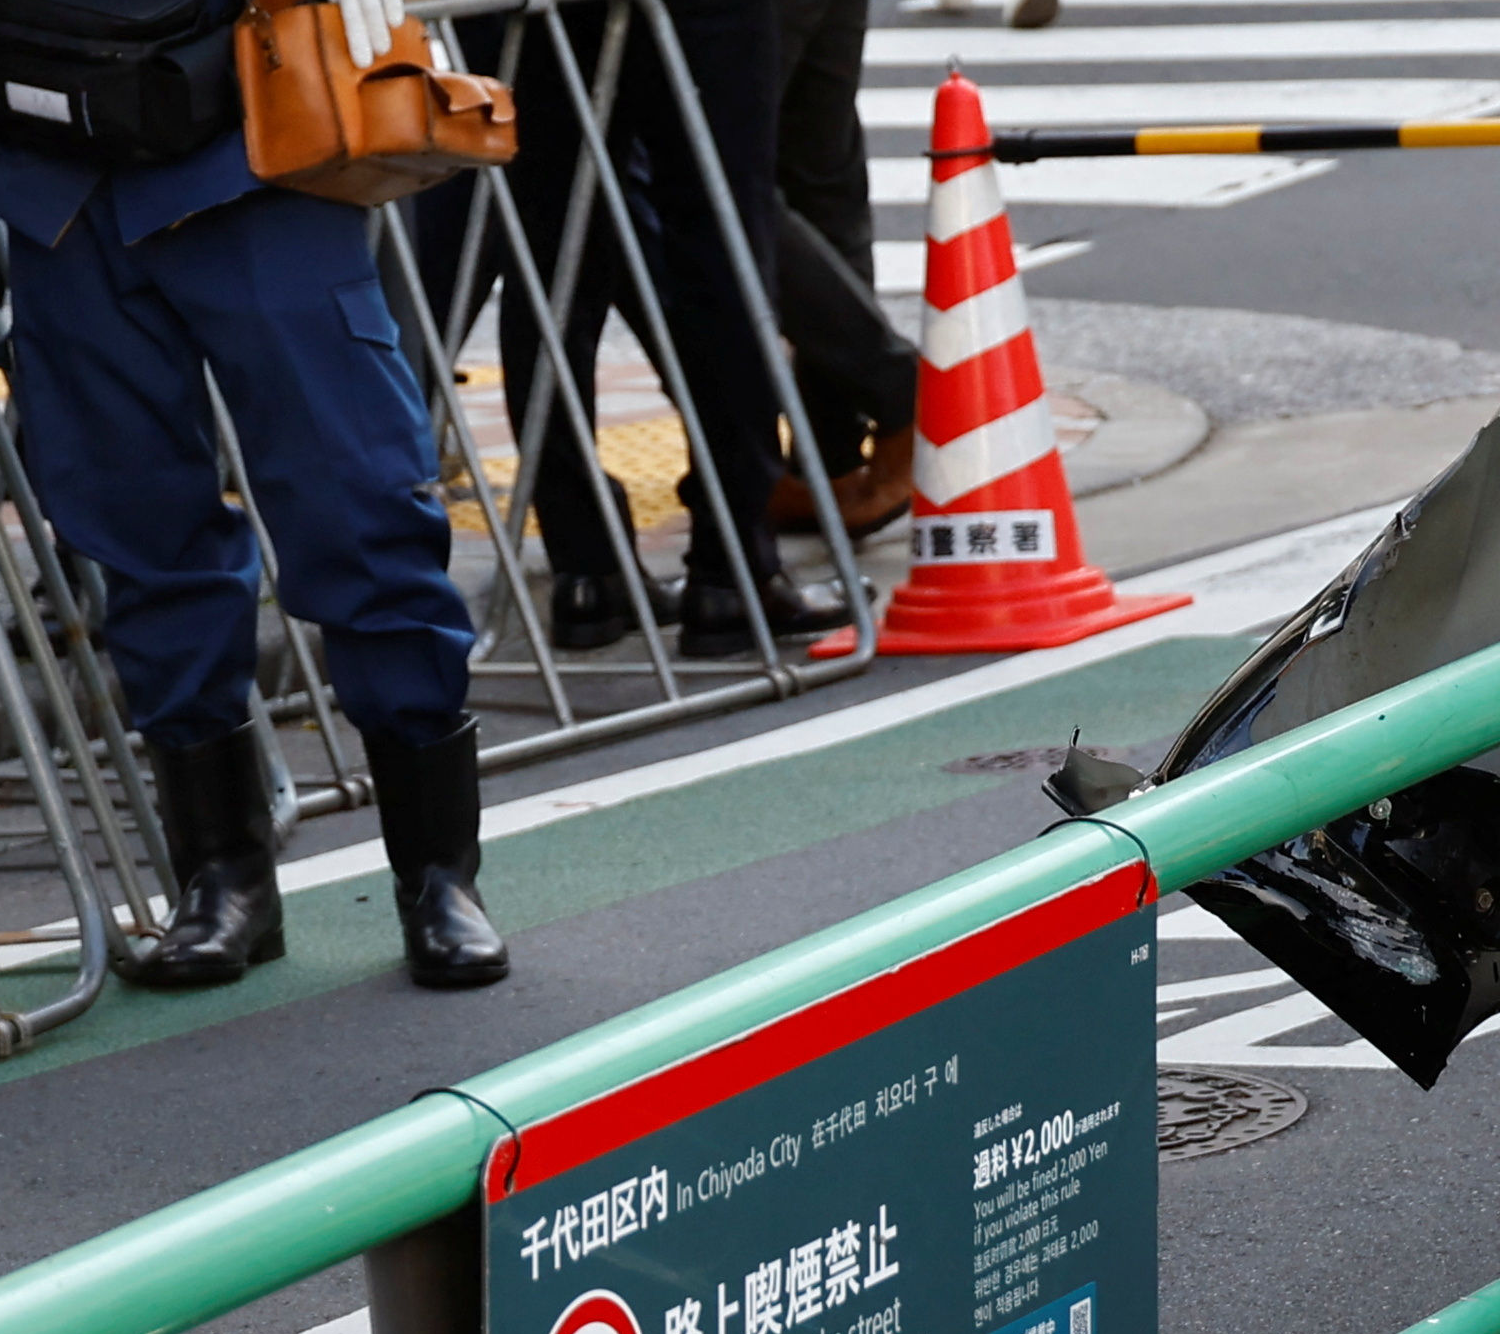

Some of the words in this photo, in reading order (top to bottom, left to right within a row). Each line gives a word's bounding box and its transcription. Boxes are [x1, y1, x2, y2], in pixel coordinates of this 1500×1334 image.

[875, 1074, 917, 1117] 치요다
[923, 1065, 938, 1096] 구
[944, 1054, 958, 1084] 에
[974, 1103, 1022, 1139] 違反した場合は
[811, 1100, 866, 1149] 在千代田
[973, 1139, 1008, 1190] 過料
[1011, 1110, 1074, 1169] ¥2,000
[676, 1182, 693, 1212] In
[697, 1147, 765, 1201] Chiyoda
[769, 1133, 801, 1168] City
[973, 1199, 995, 1220] You
[996, 1183, 1015, 1209] will
[1017, 1179, 1030, 1200] be
[1031, 1160, 1058, 1191] fined
[1060, 1147, 1087, 1178] 2,000
[1088, 1141, 1108, 1162] Yen
[521, 1166, 668, 1279] 千代田区内
[974, 1222, 982, 1245] if
[983, 1219, 1003, 1246] you
[1004, 1200, 1039, 1229] violate
[1040, 1187, 1059, 1211] this
[1060, 1176, 1081, 1201] rule
[1018, 1224, 1041, 1251] 2,000
[1042, 1214, 1059, 1238] 日元
[974, 1270, 1001, 1299] 위반한
[1042, 1236, 1068, 1262] 과태료
[1070, 1219, 1099, 1249] 2,000
